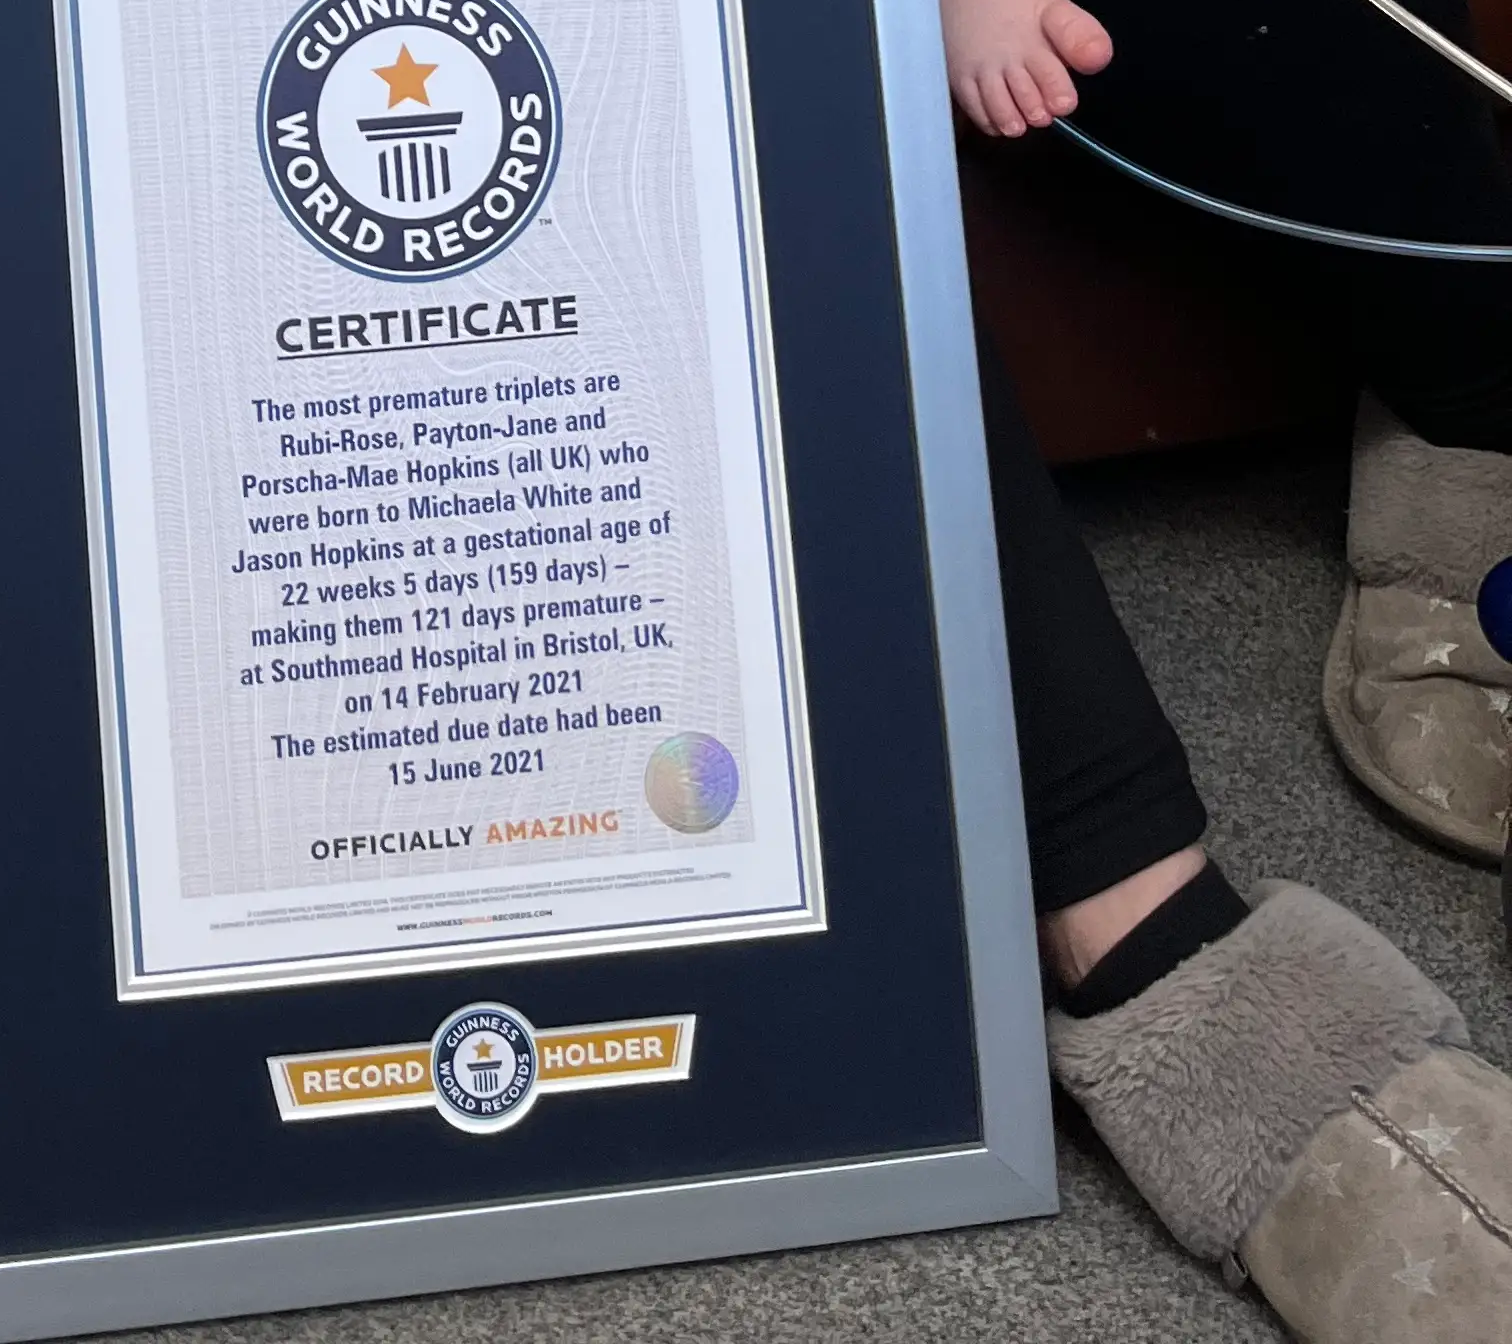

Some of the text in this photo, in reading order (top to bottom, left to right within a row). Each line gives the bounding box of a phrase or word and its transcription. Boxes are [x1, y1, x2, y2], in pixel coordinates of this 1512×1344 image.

[276, 93, 543, 262] WORLD RECORDS
[274, 294, 579, 354] CERTIFICATE
[251, 374, 621, 424] The most premature triplets are
[280, 406, 607, 458] Rubi-Rose, Payton-Jane and
[241, 440, 650, 498] Porscha-Mae Hopkins (all UK) who
[247, 476, 642, 535] were born to Michaela White and
[230, 510, 671, 574] Jason Hopkins at a gestational age of
[281, 582, 310, 607] 22
[316, 575, 396, 604] weeks
[402, 571, 417, 596] 5
[425, 569, 479, 597] days
[487, 560, 538, 594] (159
[545, 554, 607, 586] days)
[250, 618, 337, 647] making
[344, 614, 403, 639] them
[411, 605, 451, 632] 121
[461, 603, 516, 631] days
[522, 594, 642, 628] premature
[240, 622, 673, 686] at Southmead Hospital in Bristol, UK,
[344, 669, 582, 715] on 14 February 2021
[270, 703, 663, 760] The estimated due date had been
[387, 748, 544, 786] 15 June 2021
[310, 811, 619, 861] OFFICIALLY AMAZING
[446, 1016, 519, 1048] GUINNESS
[303, 1036, 664, 1094] RECORD HOLDER
[440, 1053, 529, 1113] WORLD RECORDS
